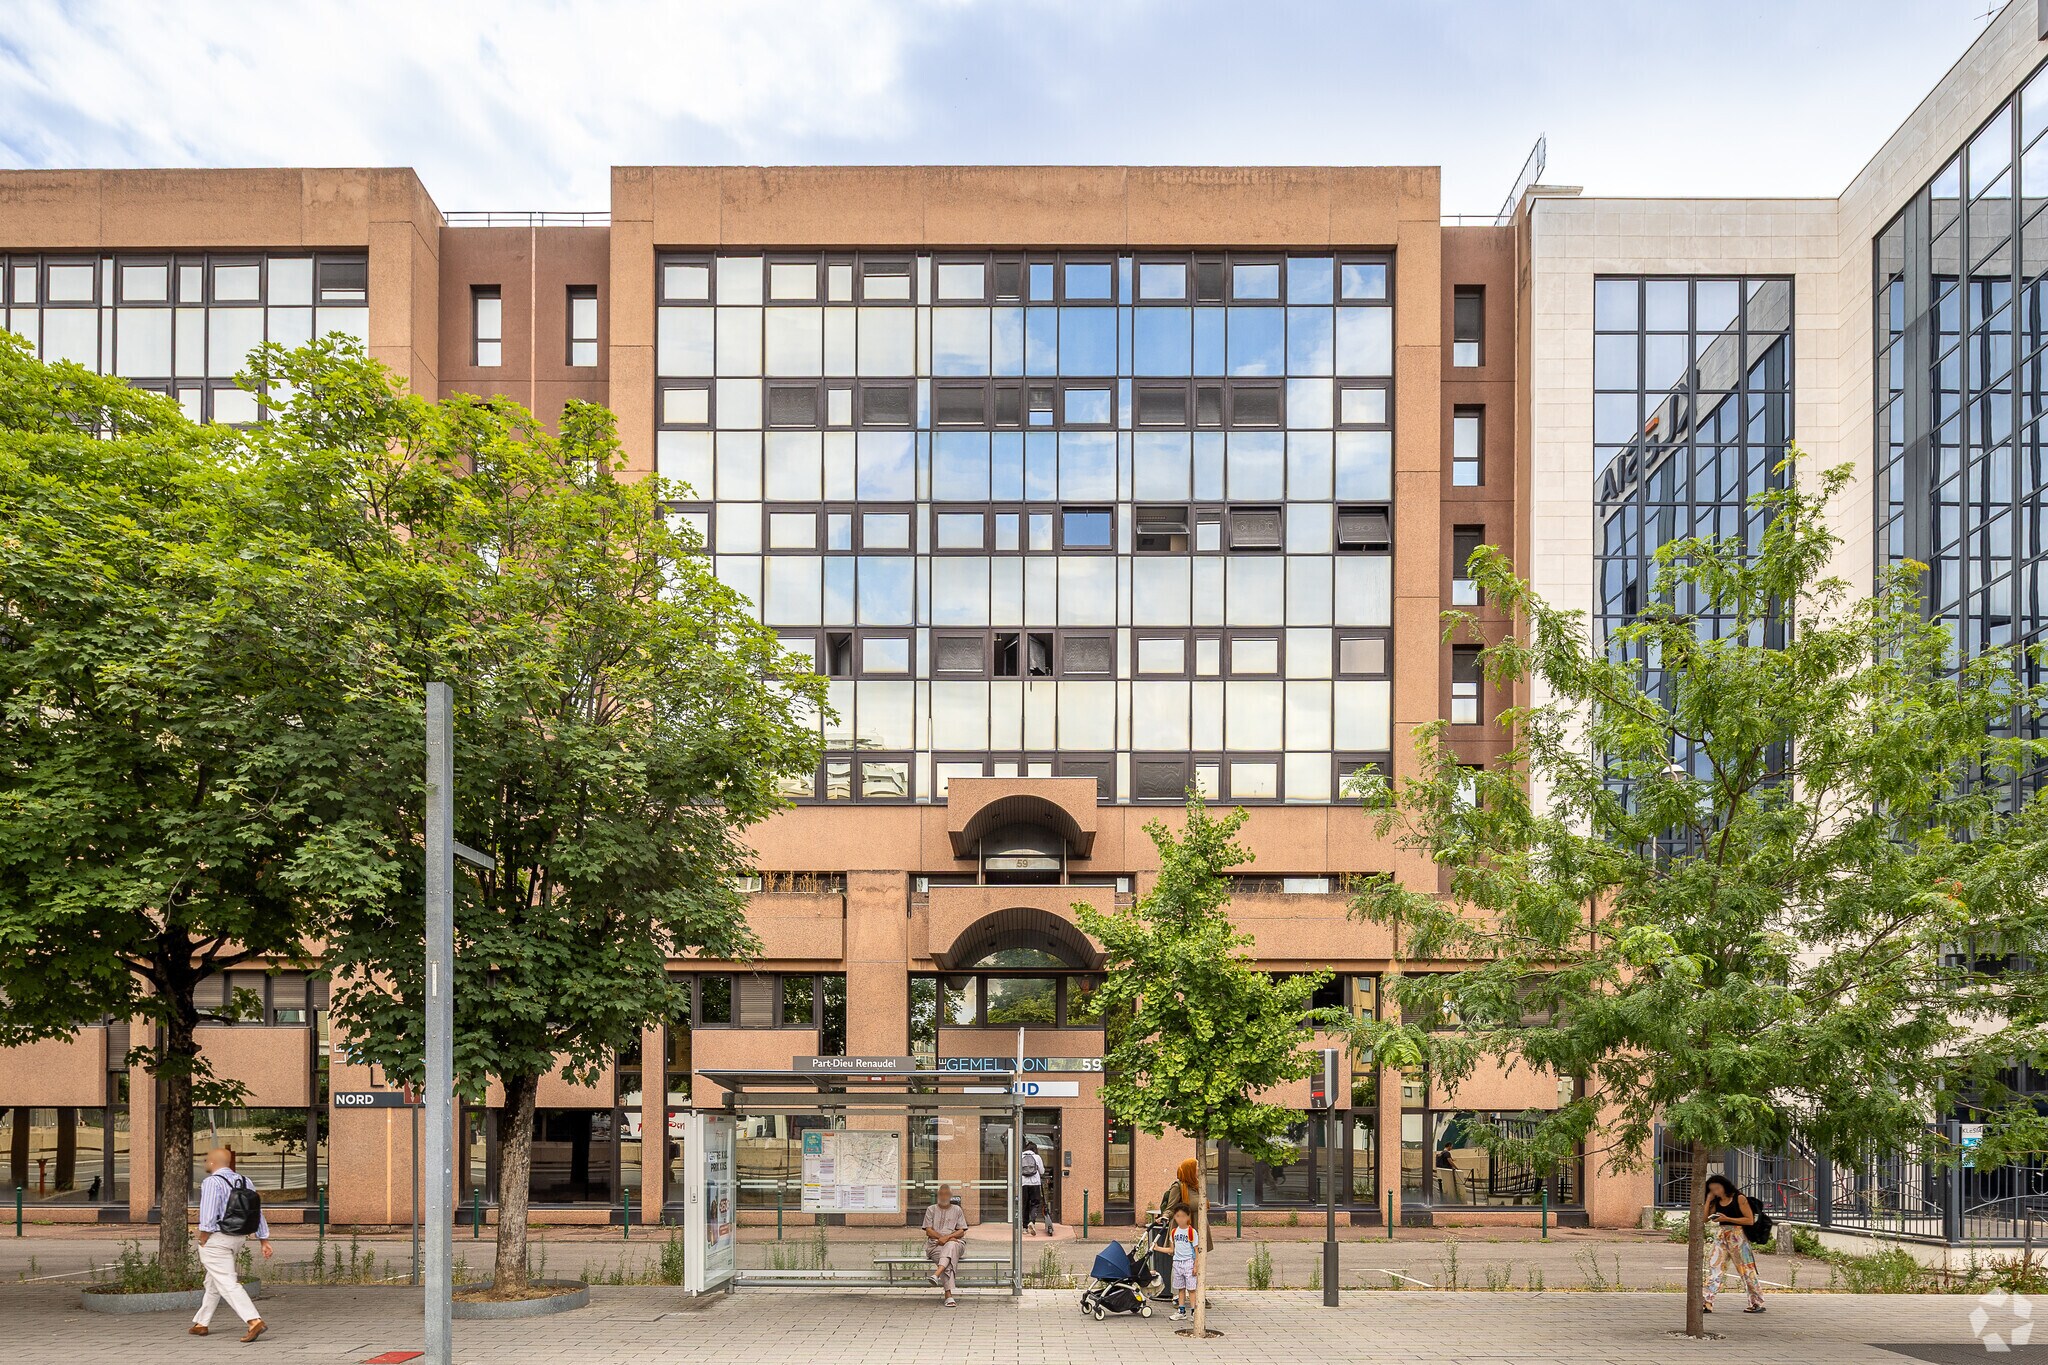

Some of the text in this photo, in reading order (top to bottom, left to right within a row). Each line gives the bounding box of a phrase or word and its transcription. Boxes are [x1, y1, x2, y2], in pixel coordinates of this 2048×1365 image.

[1016, 859, 1029, 868] 59
[812, 1058, 897, 1068] Part-Dieu Renaudel
[1082, 1059, 1101, 1071] 59
[335, 1094, 374, 1105] NORD
[1174, 1233, 1189, 1243] PARIS
